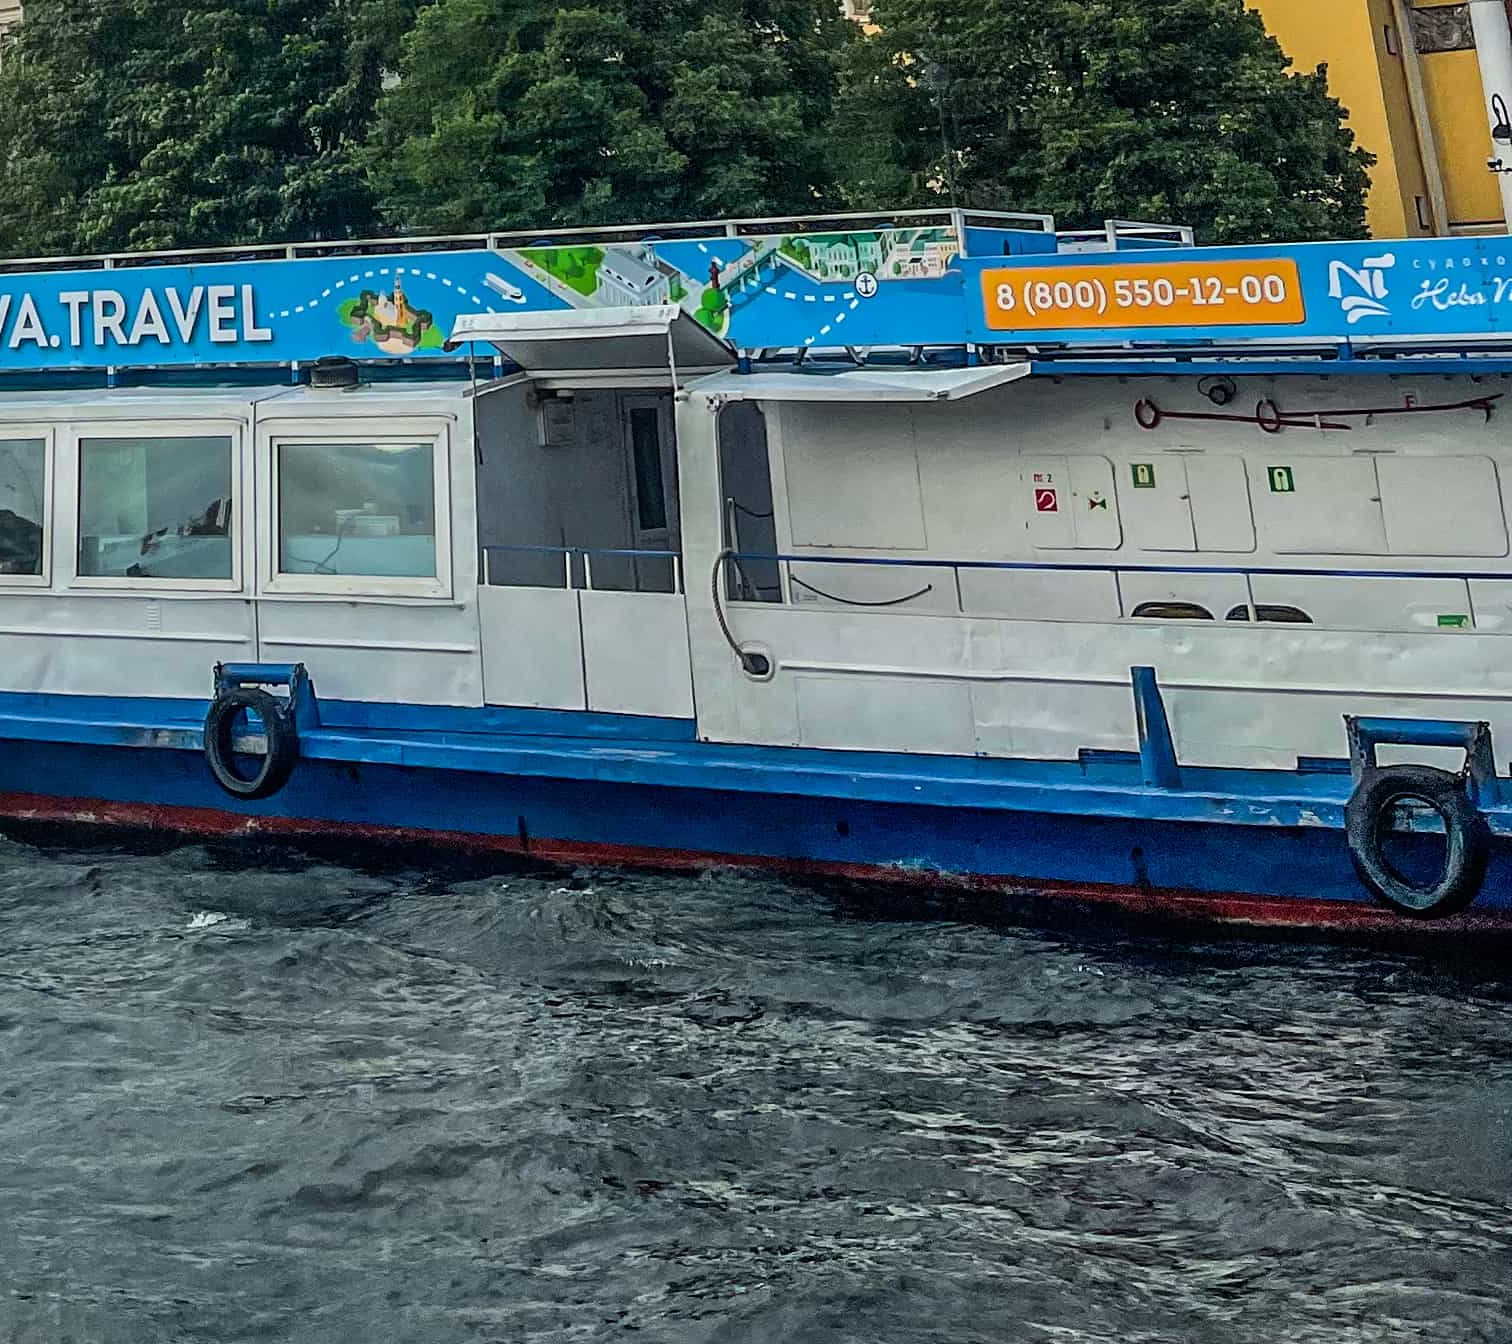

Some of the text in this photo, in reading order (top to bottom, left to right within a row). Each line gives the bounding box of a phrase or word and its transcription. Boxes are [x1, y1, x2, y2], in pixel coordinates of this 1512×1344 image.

[996, 275, 1286, 316] 8 (800) 550-12-00
